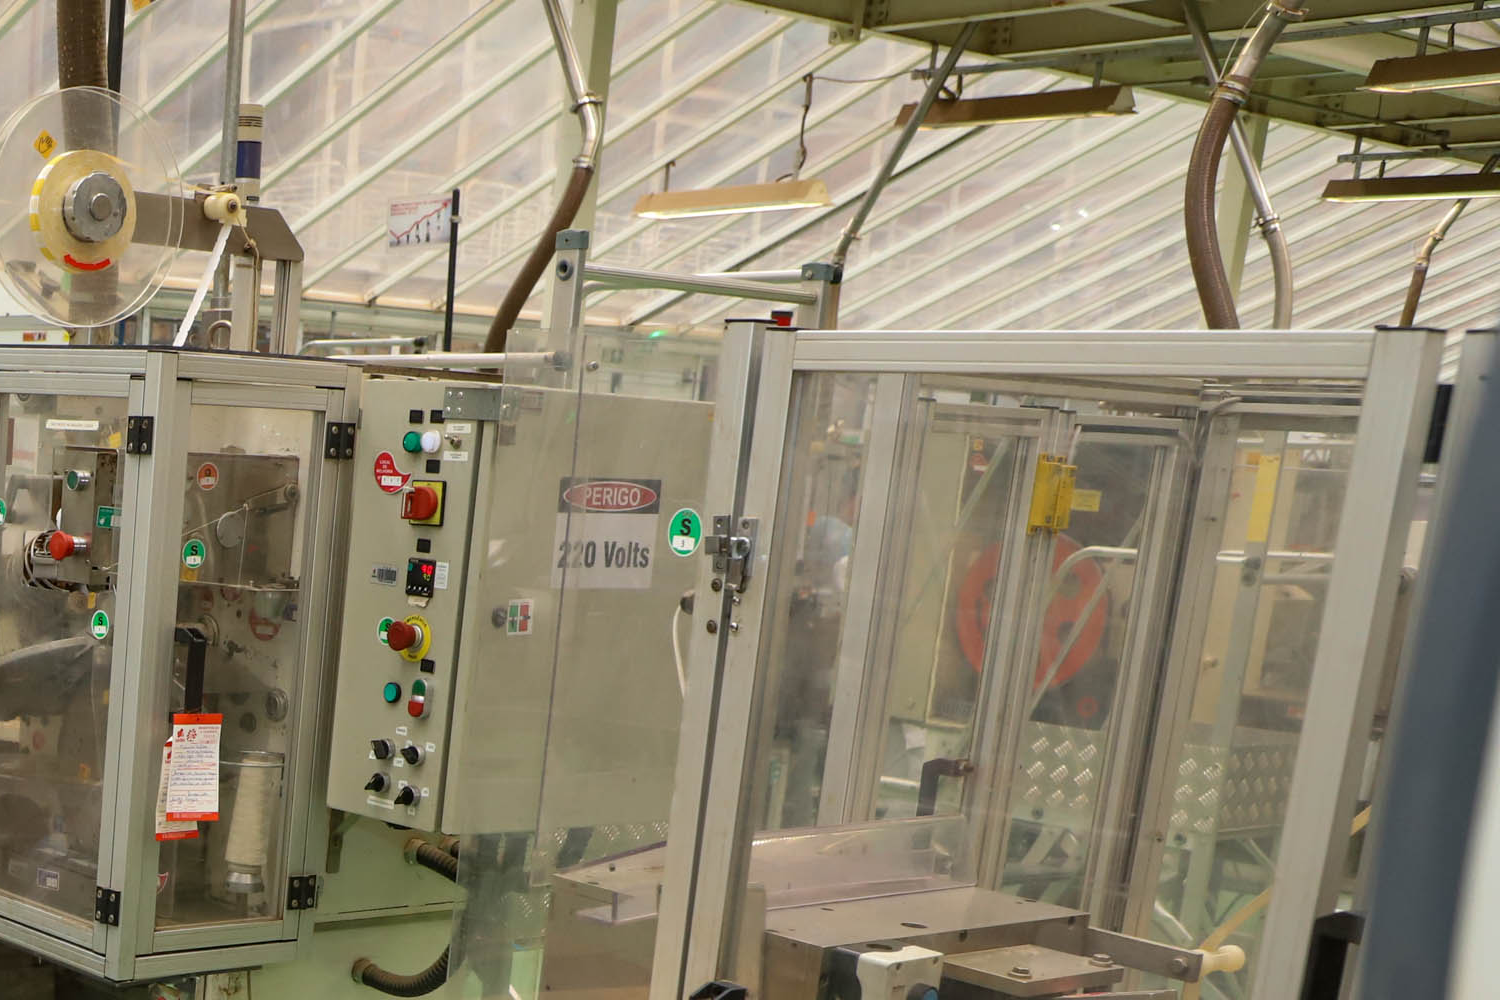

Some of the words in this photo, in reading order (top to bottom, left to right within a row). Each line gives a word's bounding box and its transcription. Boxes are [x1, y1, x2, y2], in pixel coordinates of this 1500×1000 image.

[584, 487, 641, 506] PERIGO
[680, 518, 691, 536] S
[190, 545, 198, 556] S
[557, 541, 596, 569] 220
[604, 541, 650, 569] Volts
